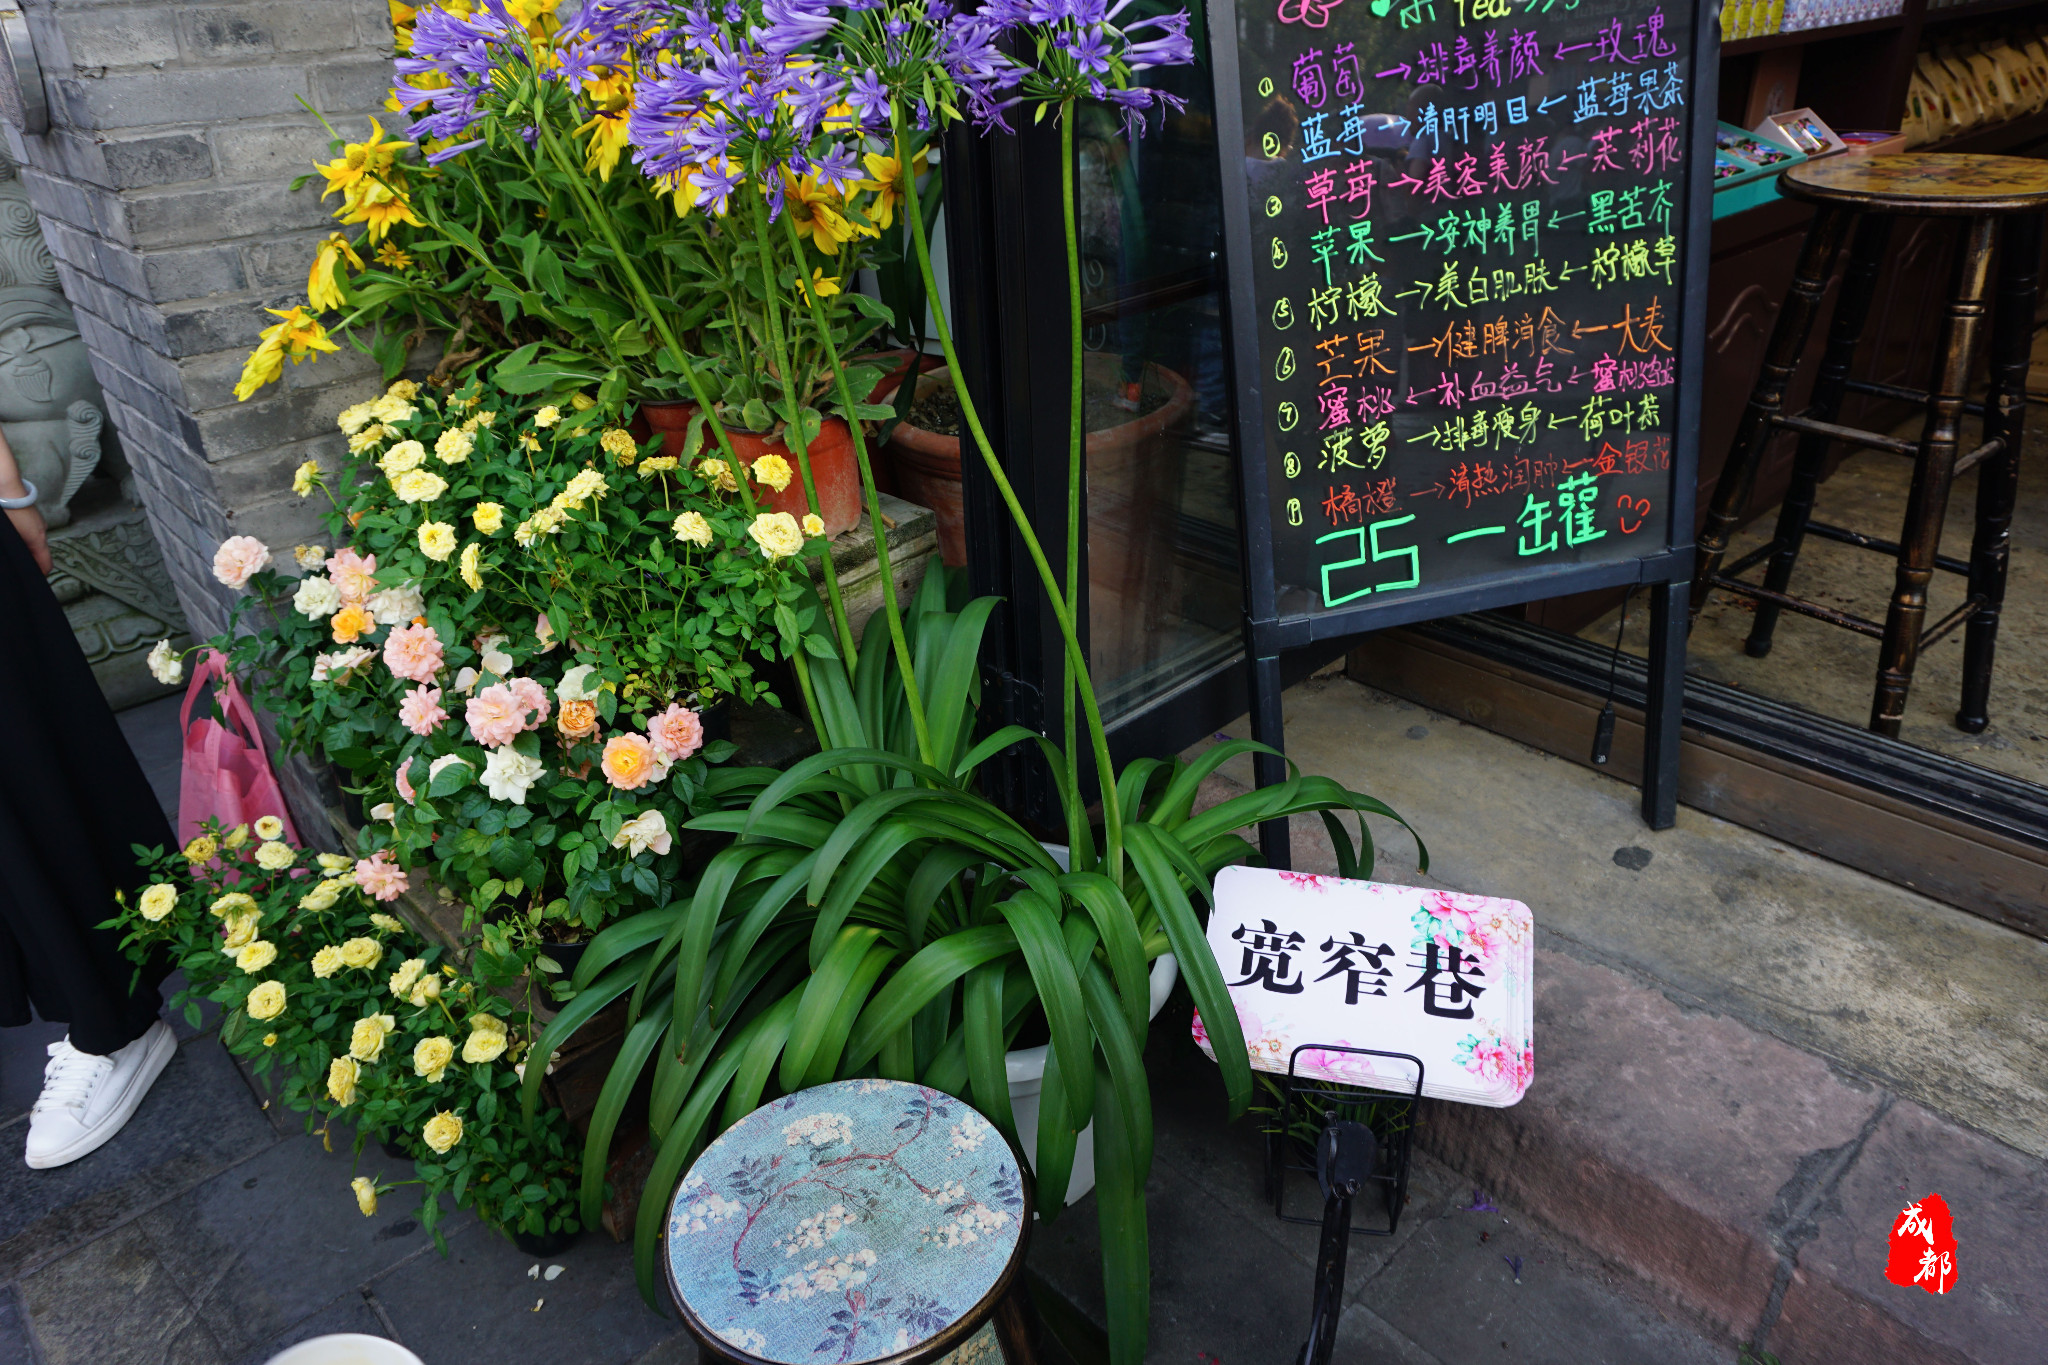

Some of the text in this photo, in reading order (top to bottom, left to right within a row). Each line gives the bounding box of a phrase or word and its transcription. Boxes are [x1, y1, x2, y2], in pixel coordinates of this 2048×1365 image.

[1293, 42, 1364, 108] 葡萄
[1417, 28, 1544, 90] 排毒养颜
[1589, 6, 1676, 64] 玫瑰
[1300, 104, 1367, 164] 蓝莓
[1416, 96, 1529, 157] 清肝明目
[1573, 61, 1684, 123] 蓝莓果茶
[1305, 159, 1377, 224] 草莓
[1424, 136, 1562, 203] 美容美颜
[1592, 117, 1681, 174] 茉莉花
[1308, 272, 1400, 330] 柠檬
[1435, 259, 1562, 309] 美白肌肤
[1591, 235, 1676, 290] 柠檬草
[1311, 220, 1385, 286] 苹果
[1436, 200, 1540, 257] 安神养胃
[1315, 329, 1396, 386] 芒果
[1435, 306, 1575, 367] 健脾消食
[1612, 296, 1672, 355] 大麦
[1318, 383, 1396, 430] 蜜桃
[1438, 356, 1562, 409] 补血益气
[1318, 421, 1390, 472] 菠萝
[1441, 401, 1541, 451] 排毒瘦身
[1579, 393, 1660, 441] 荷叶茶
[1322, 477, 1403, 526] 橘橙
[1448, 454, 1557, 508] 清热润肺
[1593, 436, 1669, 476] 金银花
[1227, 919, 1487, 1020] 宽窄巷
